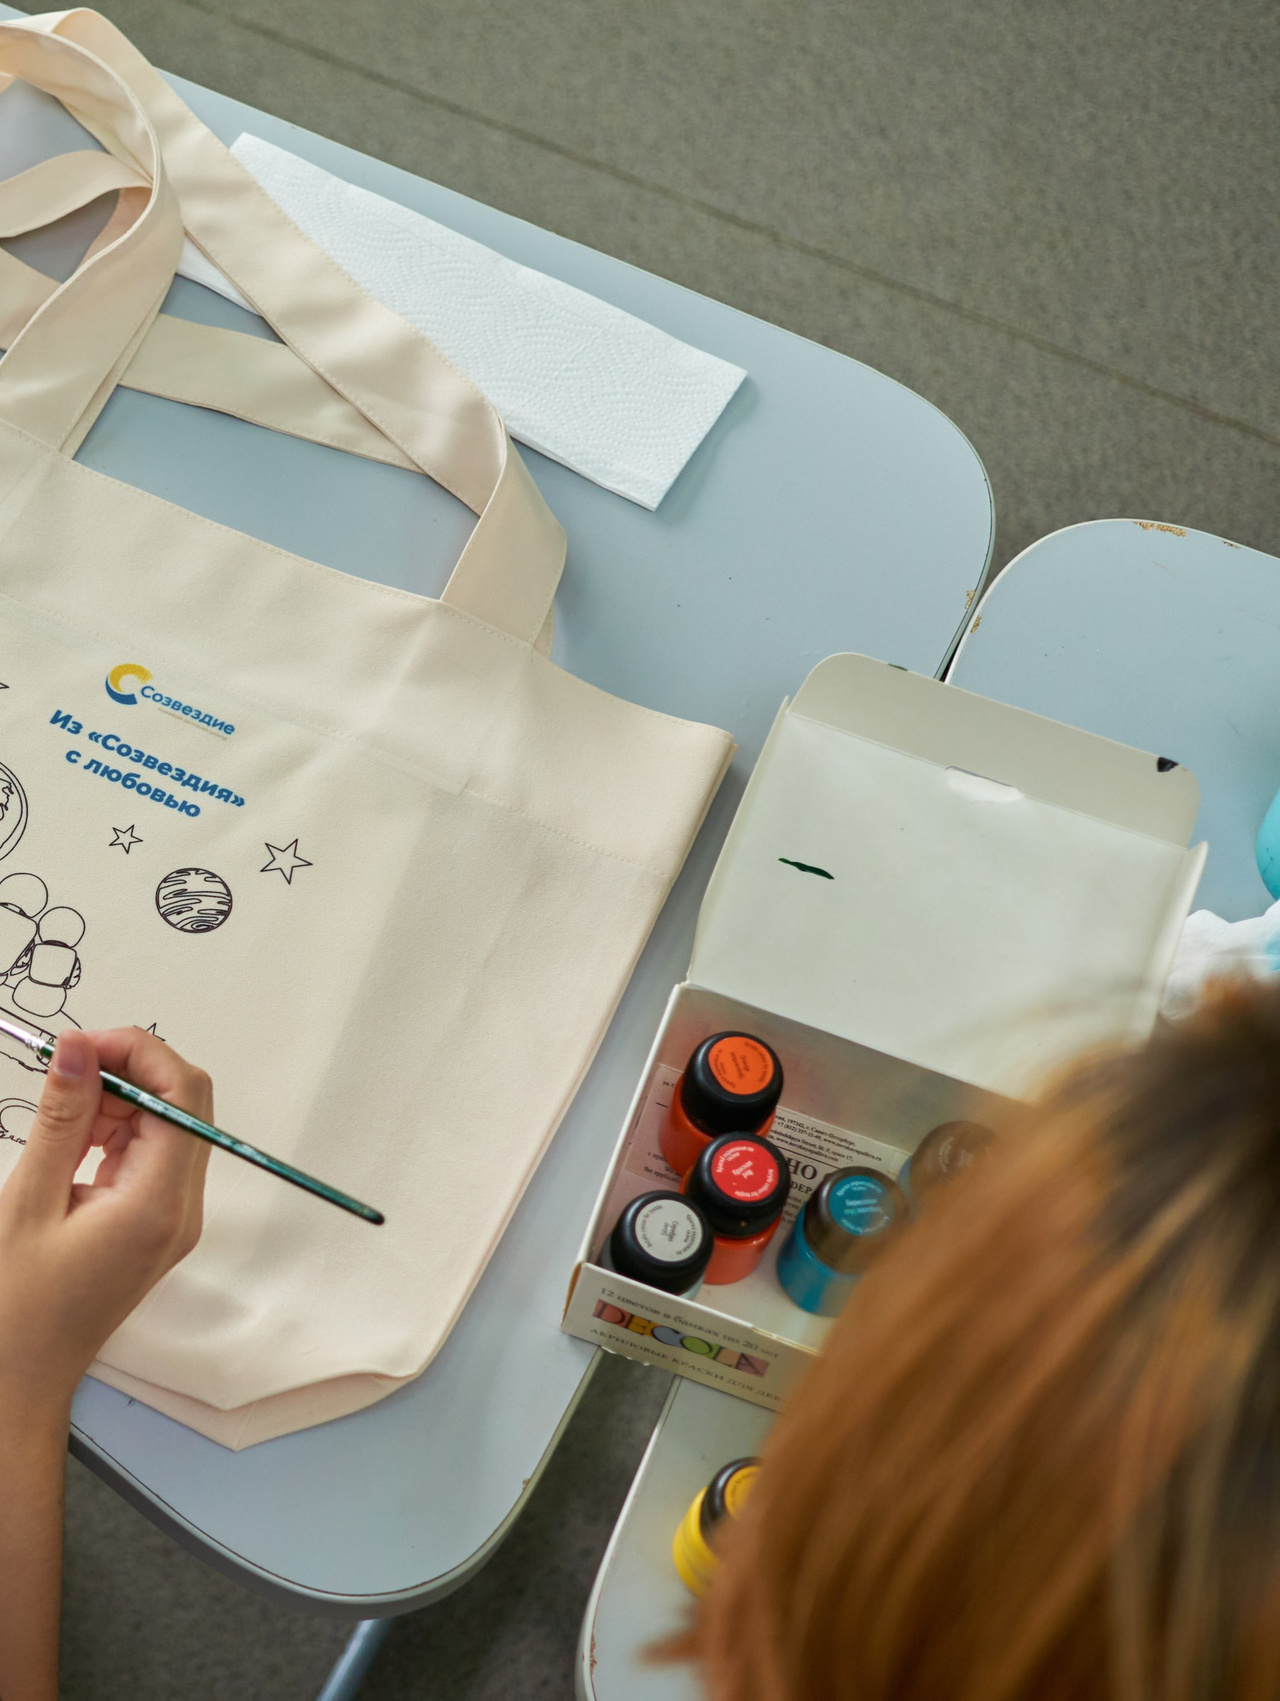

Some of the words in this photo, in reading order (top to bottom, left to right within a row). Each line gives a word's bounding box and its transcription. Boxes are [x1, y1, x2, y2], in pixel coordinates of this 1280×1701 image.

[140, 685, 236, 736] Созвездие
[49, 709, 84, 735] Из
[87, 731, 246, 808] «Созвездия»
[65, 749, 82, 764] с
[83, 758, 201, 818] любовью
[594, 1300, 768, 1377] DECOLA
[600, 1287, 614, 1298] 12
[616, 1295, 661, 1315] цветов
[673, 1311, 719, 1338] банках
[741, 1336, 759, 1351] 20
[589, 1328, 669, 1360] АКРИЛОВЫЕ
[671, 1357, 725, 1382] КРАСКИ
